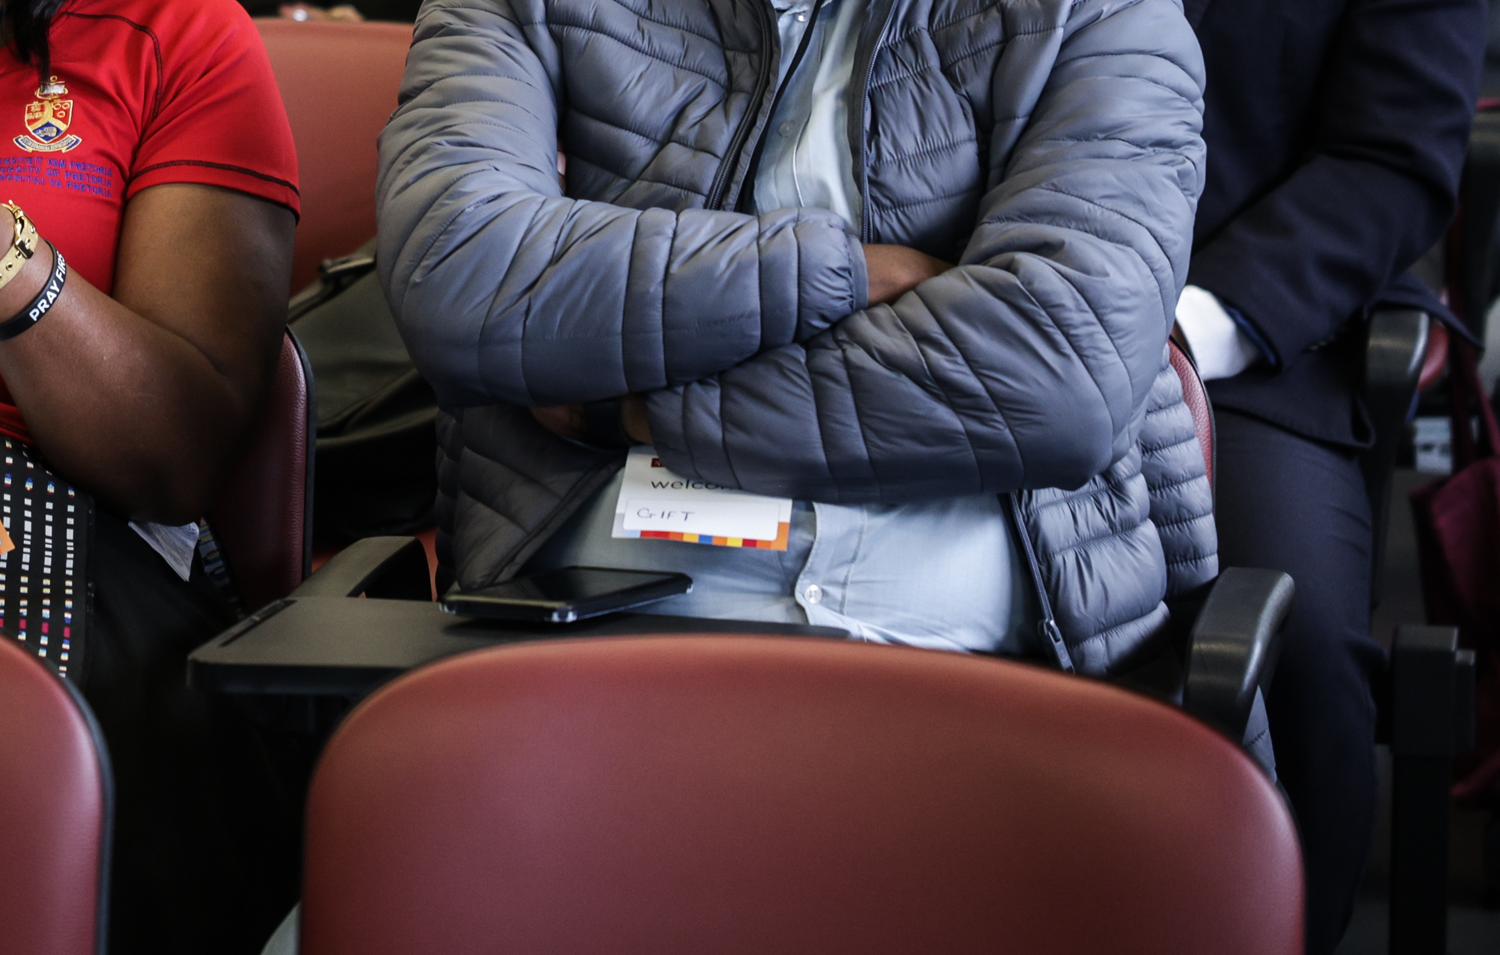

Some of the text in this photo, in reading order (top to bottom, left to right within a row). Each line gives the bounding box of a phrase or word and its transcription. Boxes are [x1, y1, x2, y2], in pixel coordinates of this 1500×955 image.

[47, 158, 66, 169] VAN
[69, 161, 112, 177] PRETORIA
[46, 168, 59, 178] OF
[64, 171, 112, 188] PRETORIA
[29, 250, 66, 322] PRAY FIRS
[637, 507, 695, 522] GIFT
